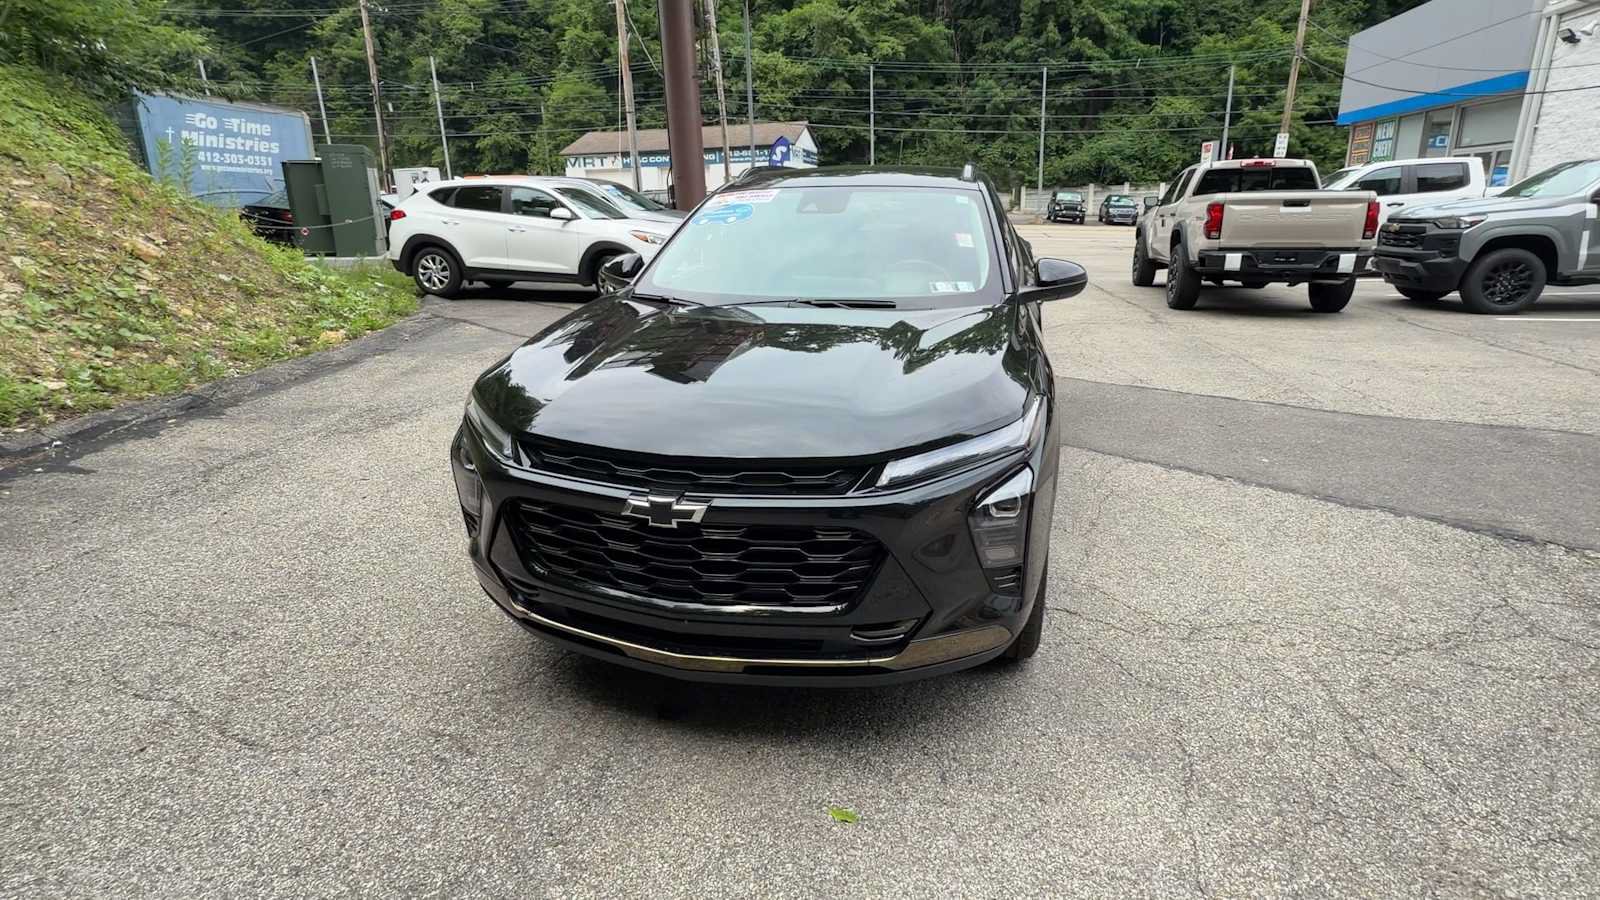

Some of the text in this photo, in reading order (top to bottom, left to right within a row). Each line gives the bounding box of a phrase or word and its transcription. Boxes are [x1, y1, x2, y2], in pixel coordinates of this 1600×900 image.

[190, 113, 272, 136] Go Time
[180, 130, 280, 153] Ministries
[198, 151, 272, 166] 412-303-0351
